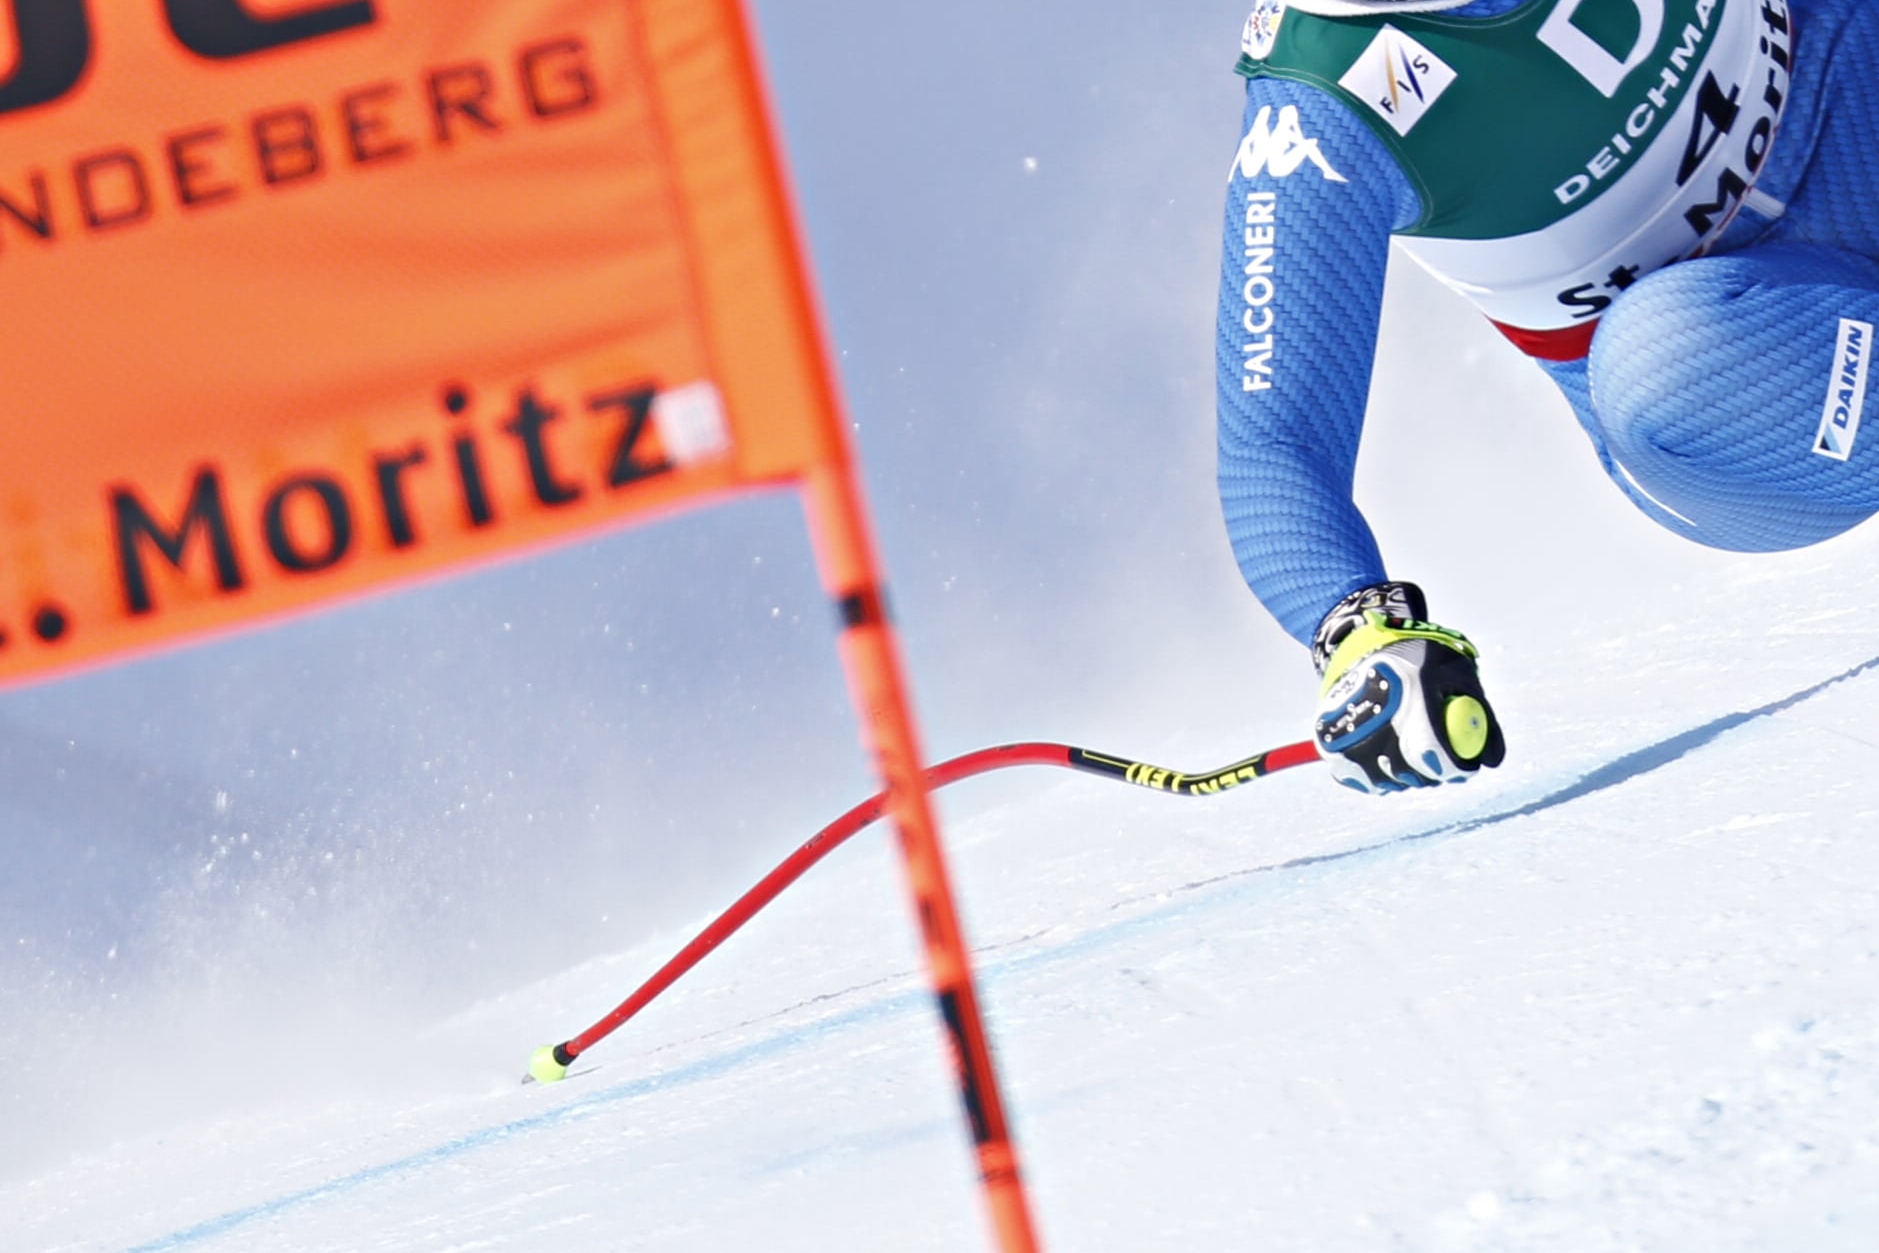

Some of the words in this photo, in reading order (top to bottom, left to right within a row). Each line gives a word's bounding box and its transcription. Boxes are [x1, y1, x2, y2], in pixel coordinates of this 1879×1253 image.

[1379, 54, 1430, 114] FIS
[1675, 68, 1741, 188] 4
[1242, 192, 1276, 392] FALCONERI
[1832, 325, 1863, 430] DAIKIN
[107, 376, 676, 617] Moritz
